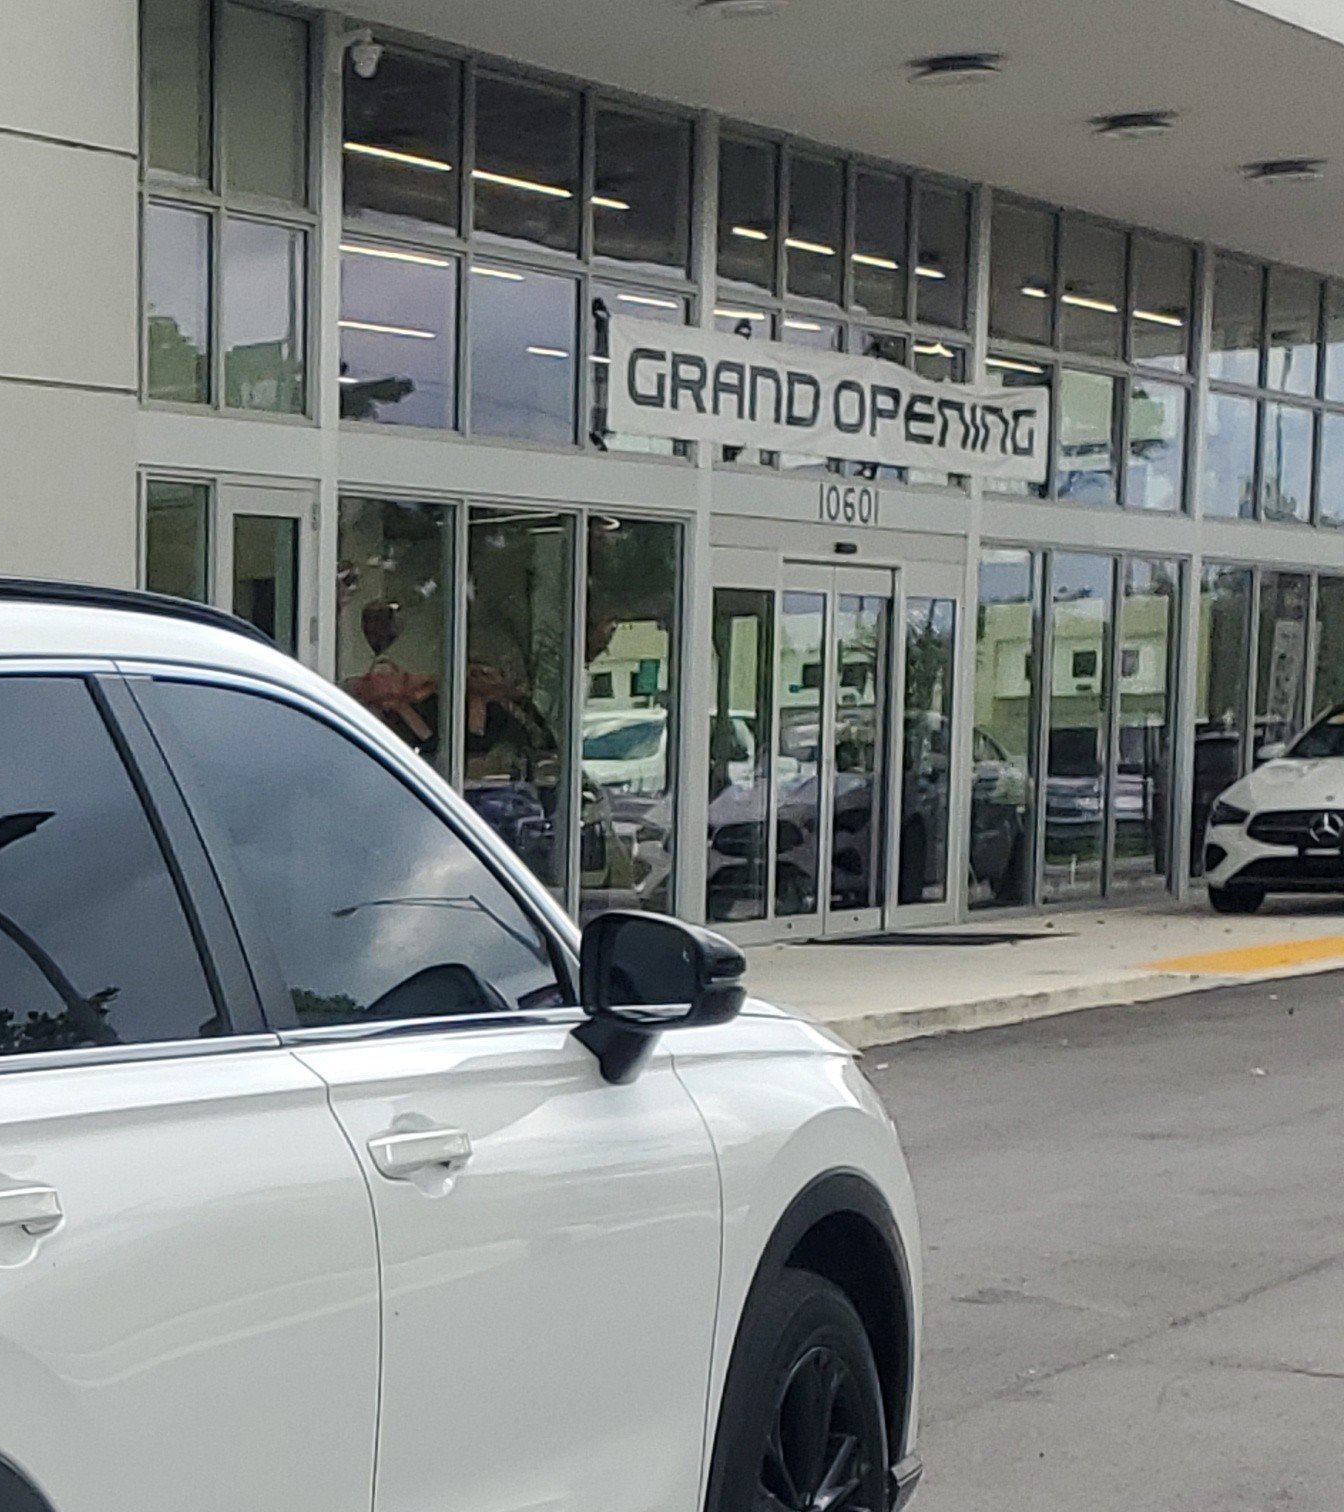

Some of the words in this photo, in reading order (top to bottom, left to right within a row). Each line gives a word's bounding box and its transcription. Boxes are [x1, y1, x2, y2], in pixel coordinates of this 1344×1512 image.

[628, 348, 821, 427] GRAND
[833, 380, 1037, 457] OPENING
[819, 483, 879, 524] 10601
